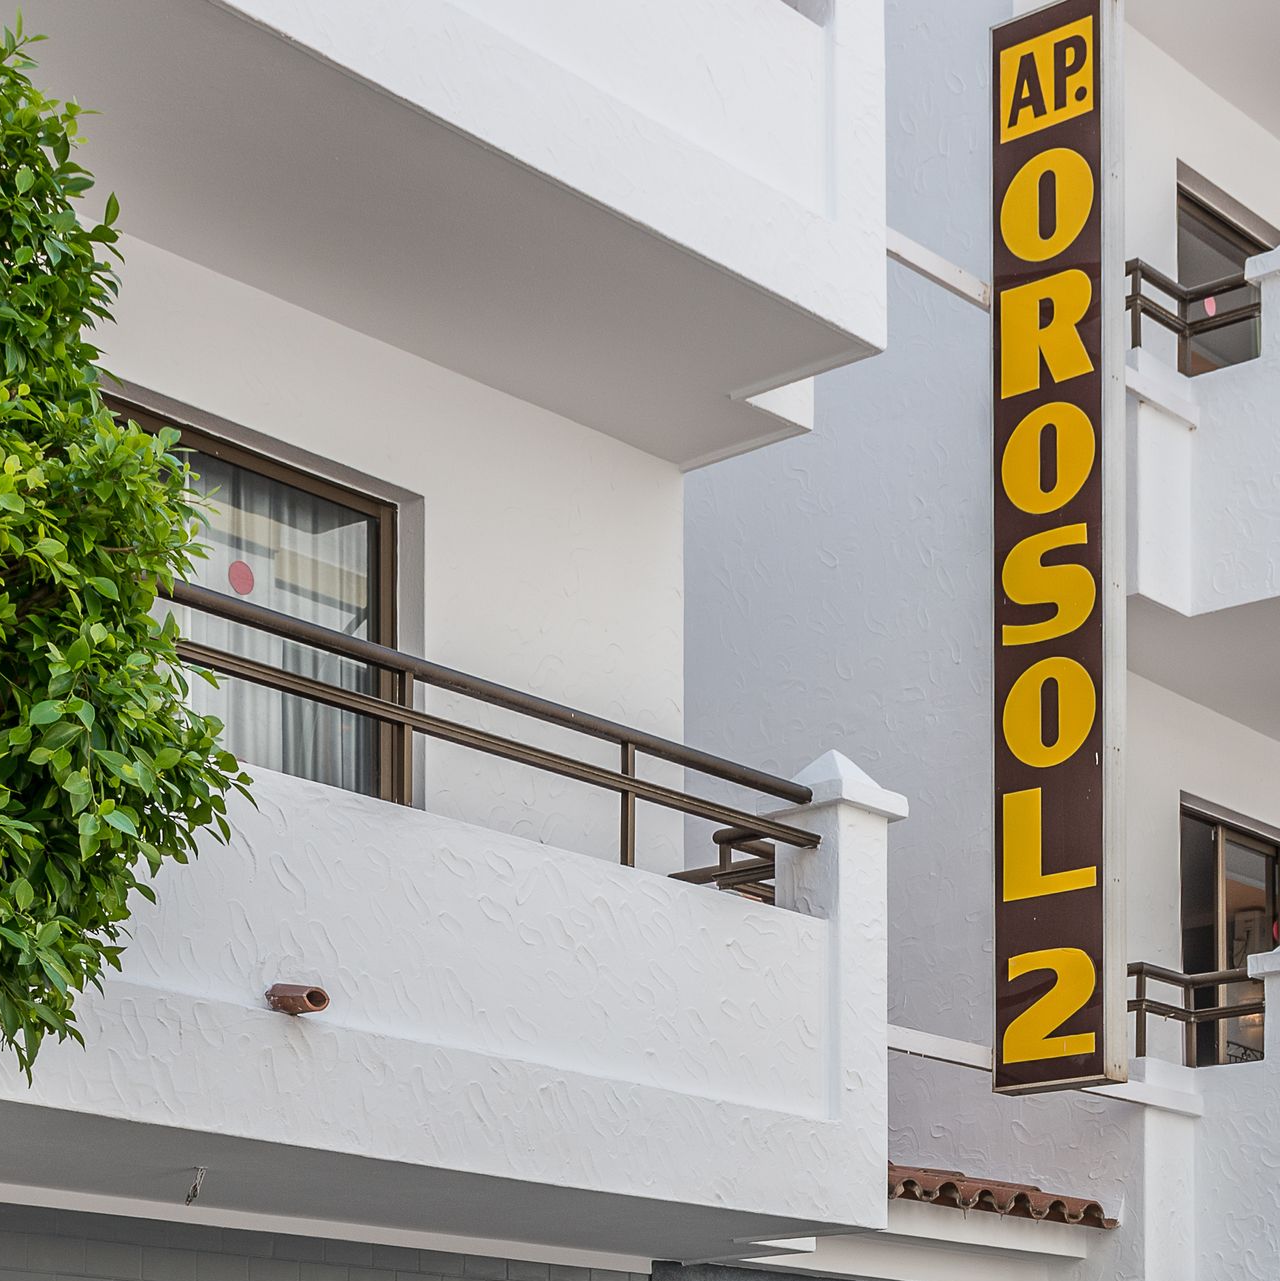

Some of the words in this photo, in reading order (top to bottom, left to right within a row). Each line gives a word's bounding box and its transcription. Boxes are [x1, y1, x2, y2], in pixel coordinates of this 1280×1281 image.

[1007, 34, 1088, 128] AP.
[1000, 147, 1095, 902] OROSOL
[1002, 946, 1095, 1064] 2
